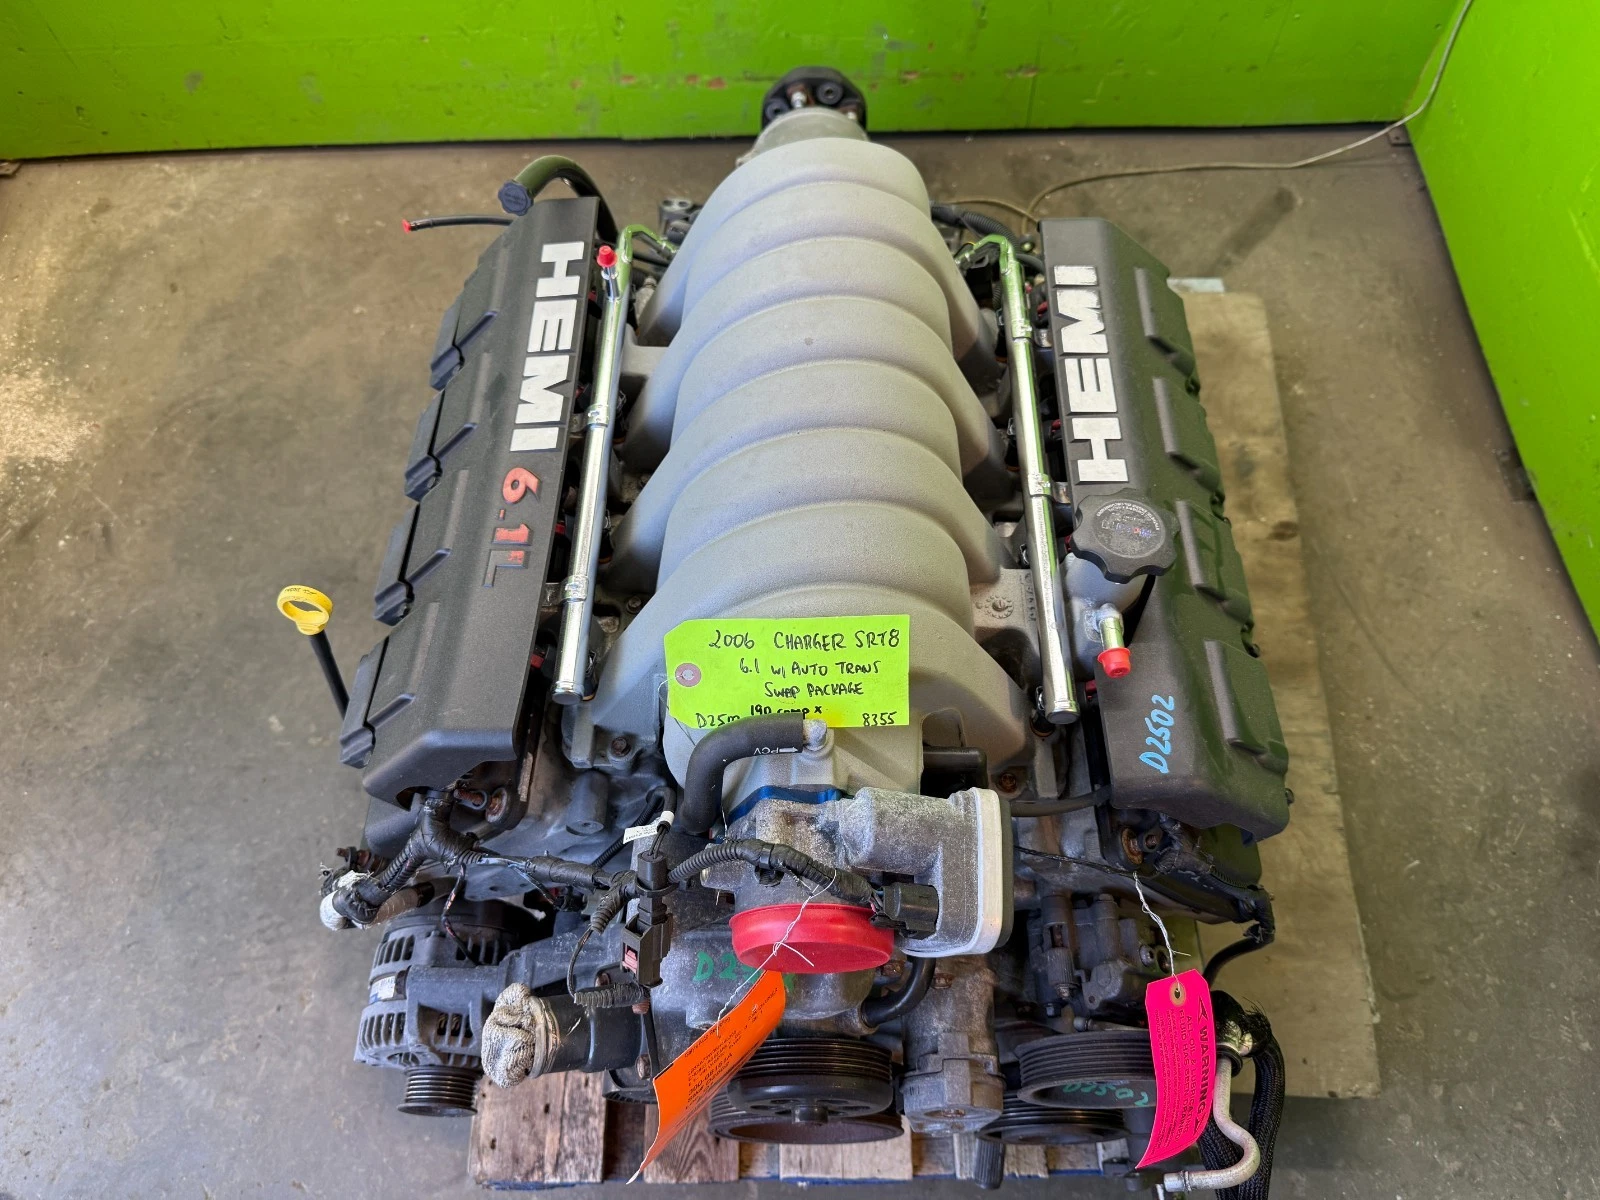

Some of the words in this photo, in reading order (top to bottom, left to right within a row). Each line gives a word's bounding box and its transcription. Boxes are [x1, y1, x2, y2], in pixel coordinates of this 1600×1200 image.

[509, 241, 585, 452] HEMI
[1053, 265, 1129, 482] HEMI
[482, 466, 541, 588] 6.1L
[708, 628, 755, 650] 2006
[773, 630, 847, 652] CHARGER
[854, 628, 901, 649] SRT8
[739, 657, 760, 675] 6.1
[791, 661, 828, 676] AUTO
[835, 660, 882, 675] TRANS
[806, 682, 864, 697] PACKAGE
[862, 711, 898, 727] 8355
[1139, 694, 1175, 774] D2502
[753, 747, 779, 756] PCV
[1178, 1009, 1187, 1040] FLUID
[1185, 1015, 1193, 1034] ALL
[1198, 1026, 1210, 1115] WARNING
[1182, 1068, 1195, 1133] LUBRICATING
